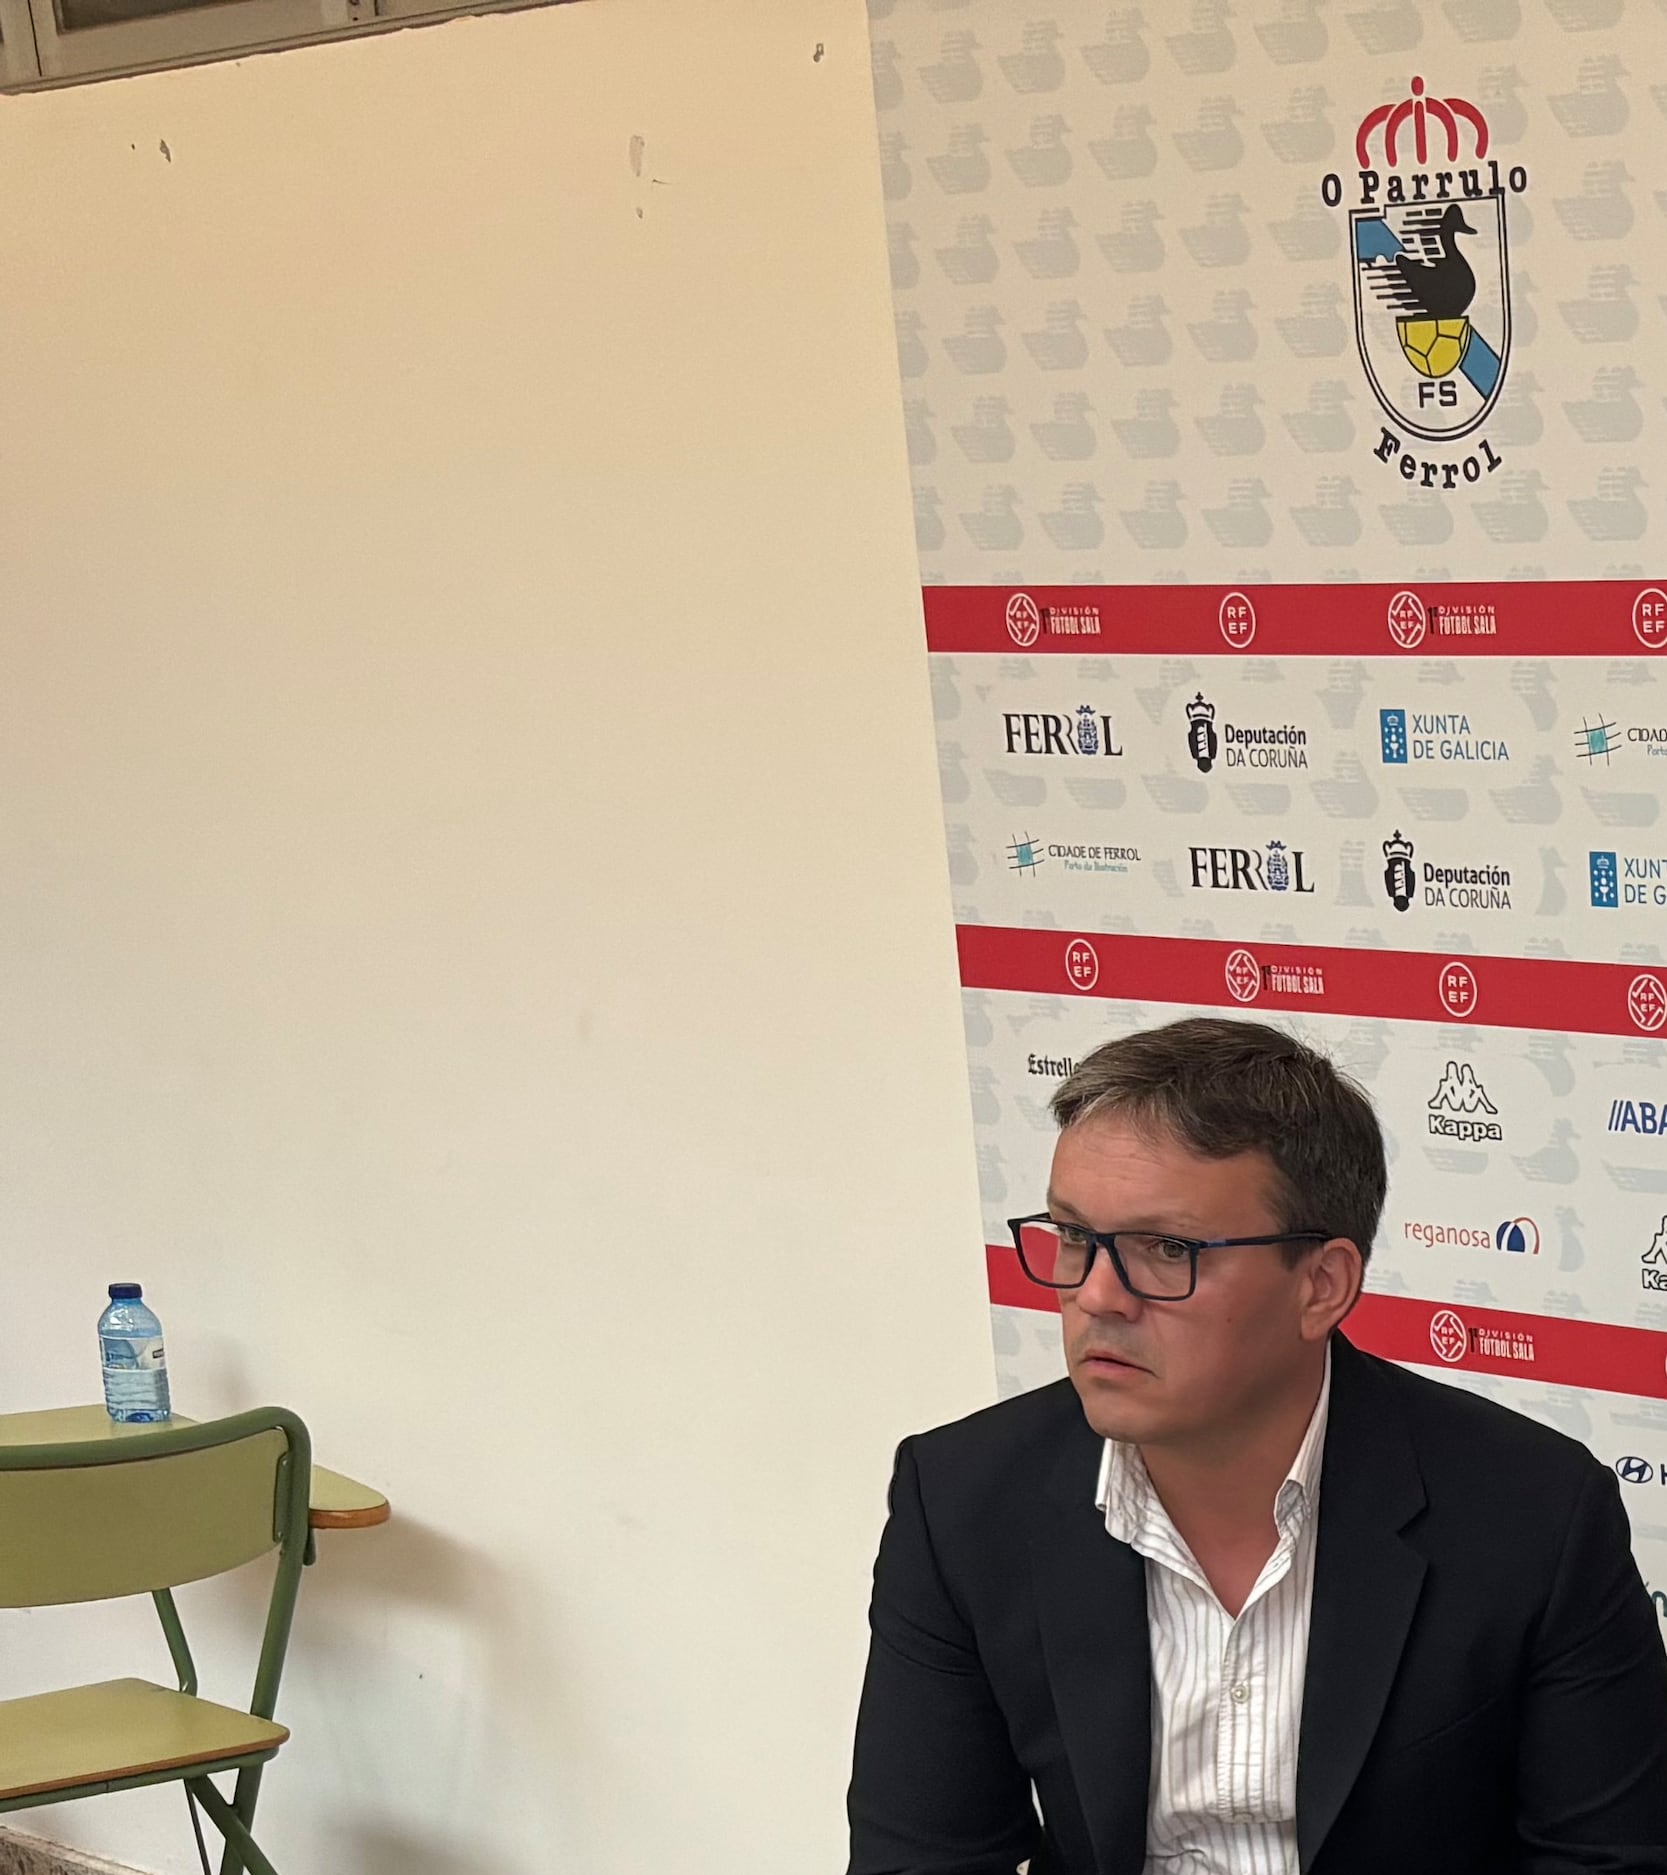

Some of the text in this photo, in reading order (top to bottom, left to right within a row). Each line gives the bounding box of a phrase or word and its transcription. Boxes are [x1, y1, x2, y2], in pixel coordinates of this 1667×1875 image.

[1322, 161, 1527, 207] O Parrulo
[1419, 381, 1457, 408] FS
[1374, 423, 1502, 488] Ferrol
[1413, 715, 1470, 734] XUNTA
[1225, 724, 1306, 756] Deputación
[1414, 740, 1509, 760] DE GALICIA
[1227, 746, 1307, 768] DA CORUÑA
[1089, 847, 1101, 859] DE
[1104, 847, 1141, 861] FERROL
[1424, 863, 1510, 896] Deputación
[1425, 887, 1511, 908] DA CORUÑA
[1625, 884, 1647, 904] DE
[1429, 1114, 1502, 1142] Kappa
[1405, 1223, 1490, 1248] reganosa
